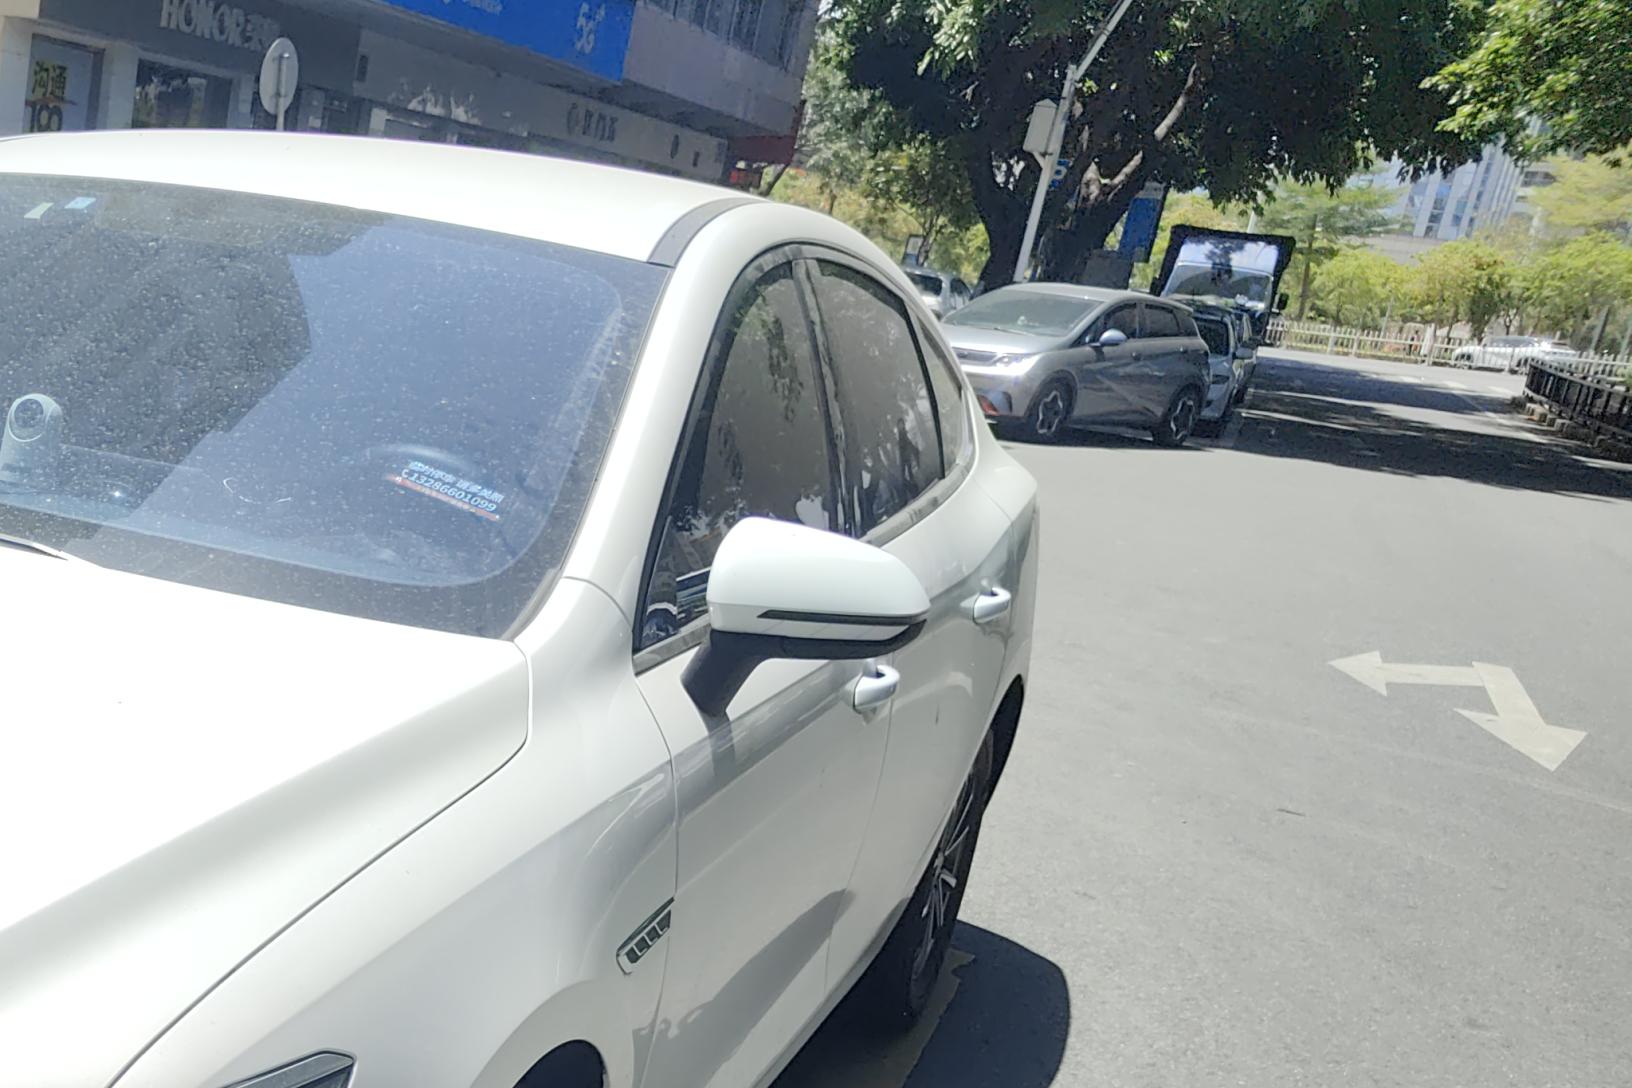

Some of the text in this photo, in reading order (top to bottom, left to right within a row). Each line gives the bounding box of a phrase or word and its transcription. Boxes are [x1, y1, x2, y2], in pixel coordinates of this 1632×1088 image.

[160, 0, 246, 48] HONOR
[32, 61, 67, 98] 沟通
[408, 473, 496, 512] 13286601099
